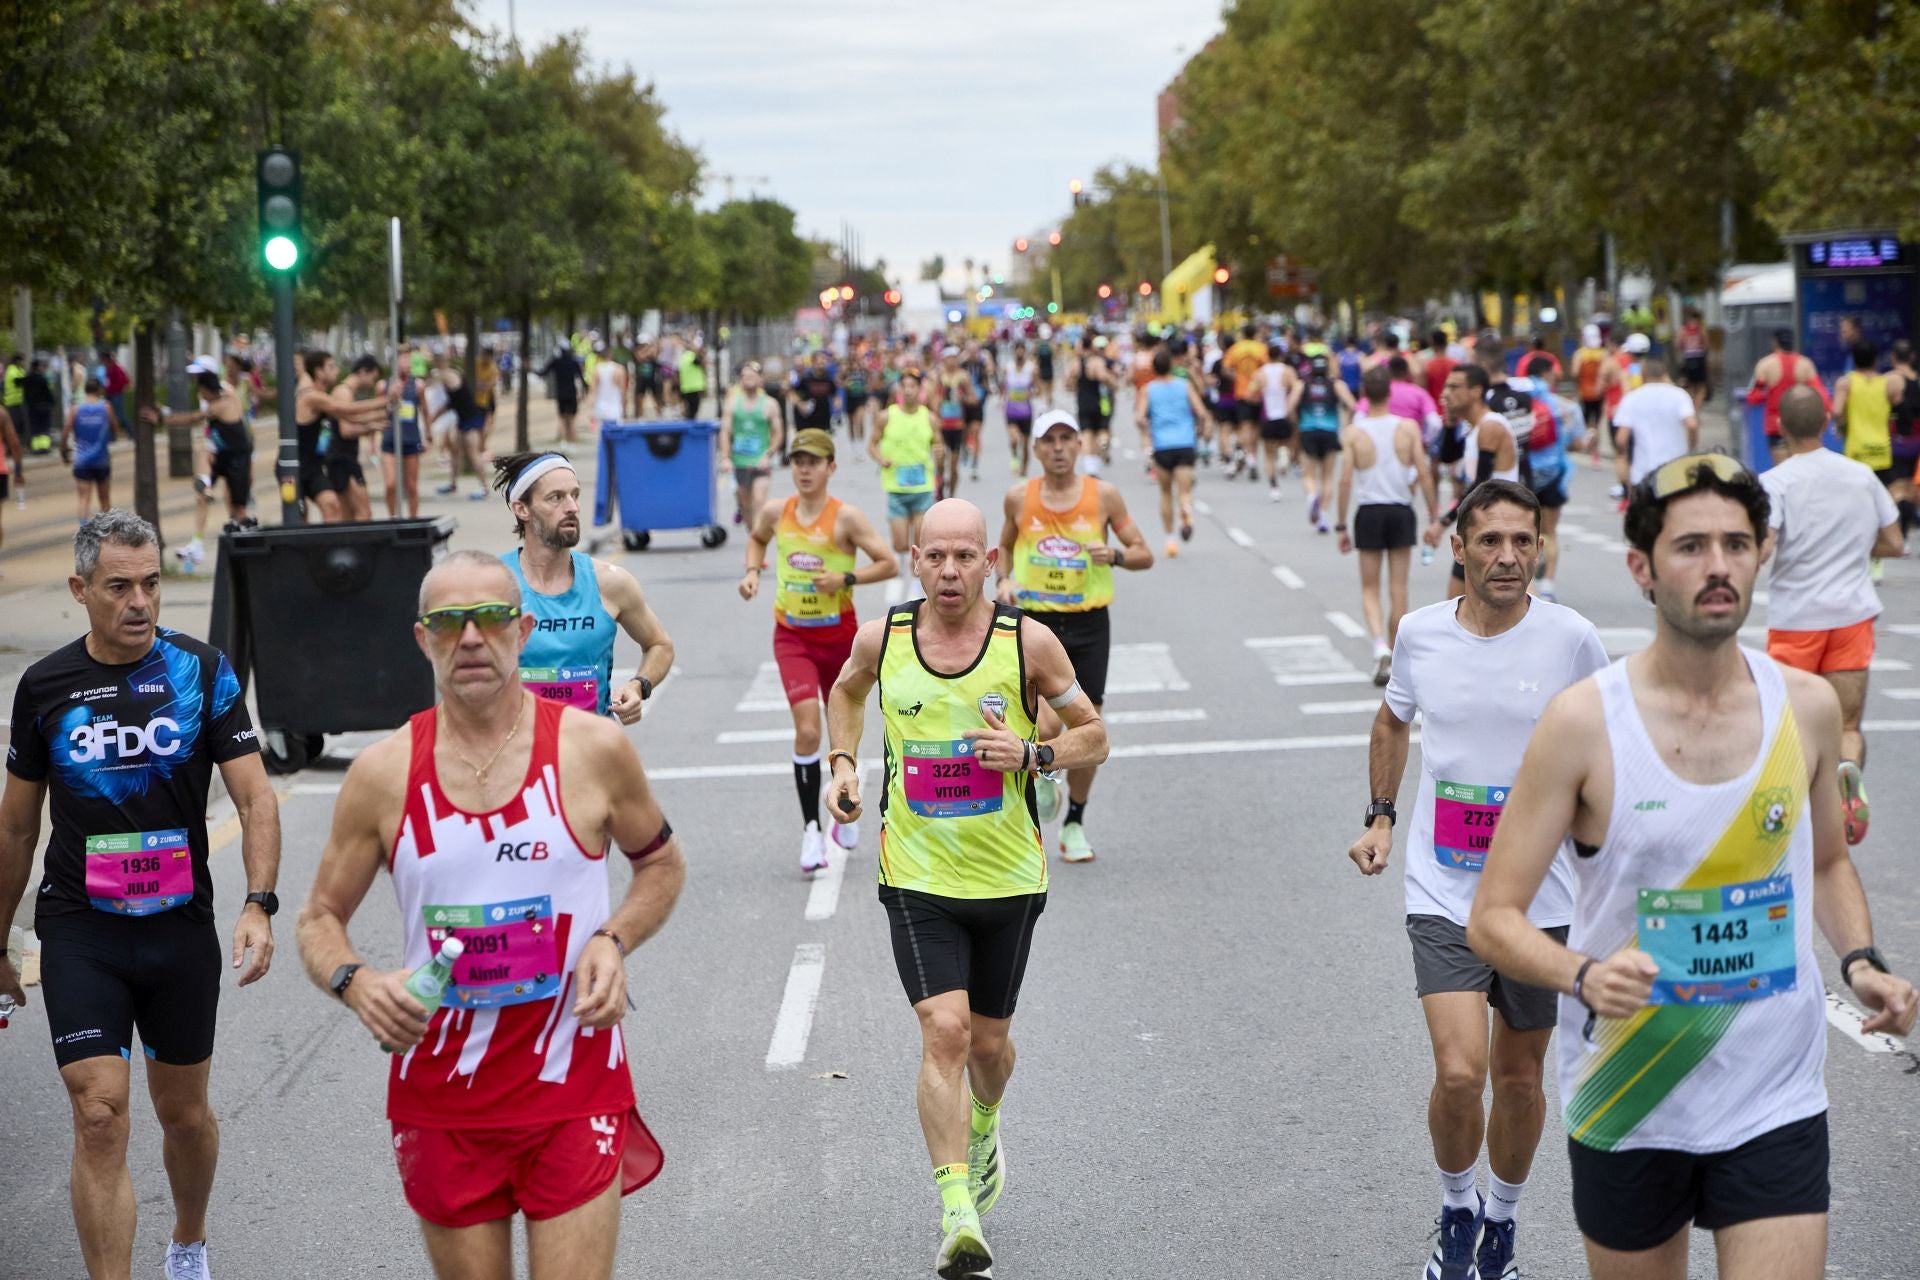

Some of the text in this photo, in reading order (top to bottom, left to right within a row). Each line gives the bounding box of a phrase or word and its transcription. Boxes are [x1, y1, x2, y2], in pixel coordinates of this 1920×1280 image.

[83, 686, 118, 697] HYUNDAI
[138, 684, 165, 693] GOBIK
[540, 686, 572, 699] 2059
[92, 714, 113, 722] TEAM
[69, 717, 181, 763] 3FDC
[932, 763, 971, 778] 3225
[934, 786, 971, 798] VITOR
[159, 834, 182, 844] ZURICH
[1468, 835, 1493, 849] LUI
[495, 842, 549, 862] RCB
[121, 857, 160, 874] 1936
[124, 881, 159, 896] JULIO
[1691, 919, 1749, 944] 1443
[463, 932, 509, 955] 2091
[1687, 951, 1754, 976] JUANKI
[65, 1029, 102, 1040] HYUNDAI
